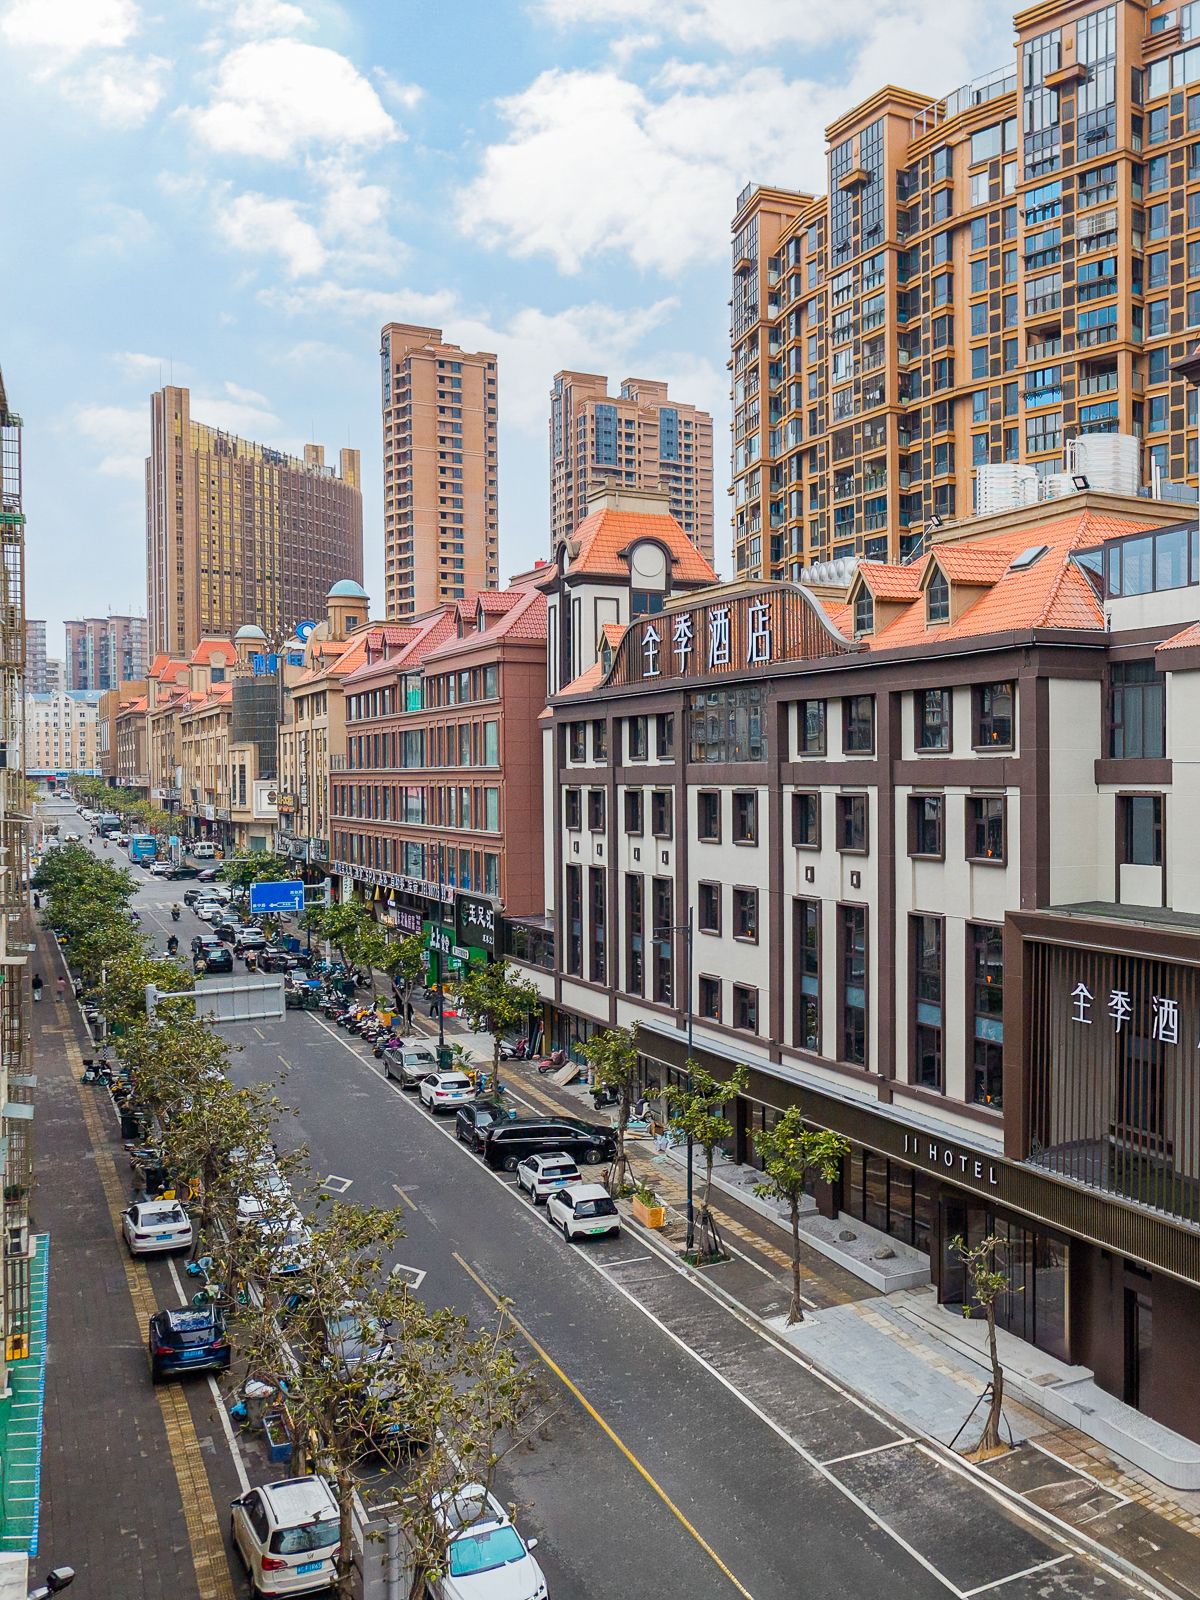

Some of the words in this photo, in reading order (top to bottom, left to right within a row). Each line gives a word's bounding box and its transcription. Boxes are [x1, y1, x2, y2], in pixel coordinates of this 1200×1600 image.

[641, 599, 771, 677] 全季酒店
[904, 1134, 917, 1154] JI
[929, 1143, 998, 1185] HOTEL
